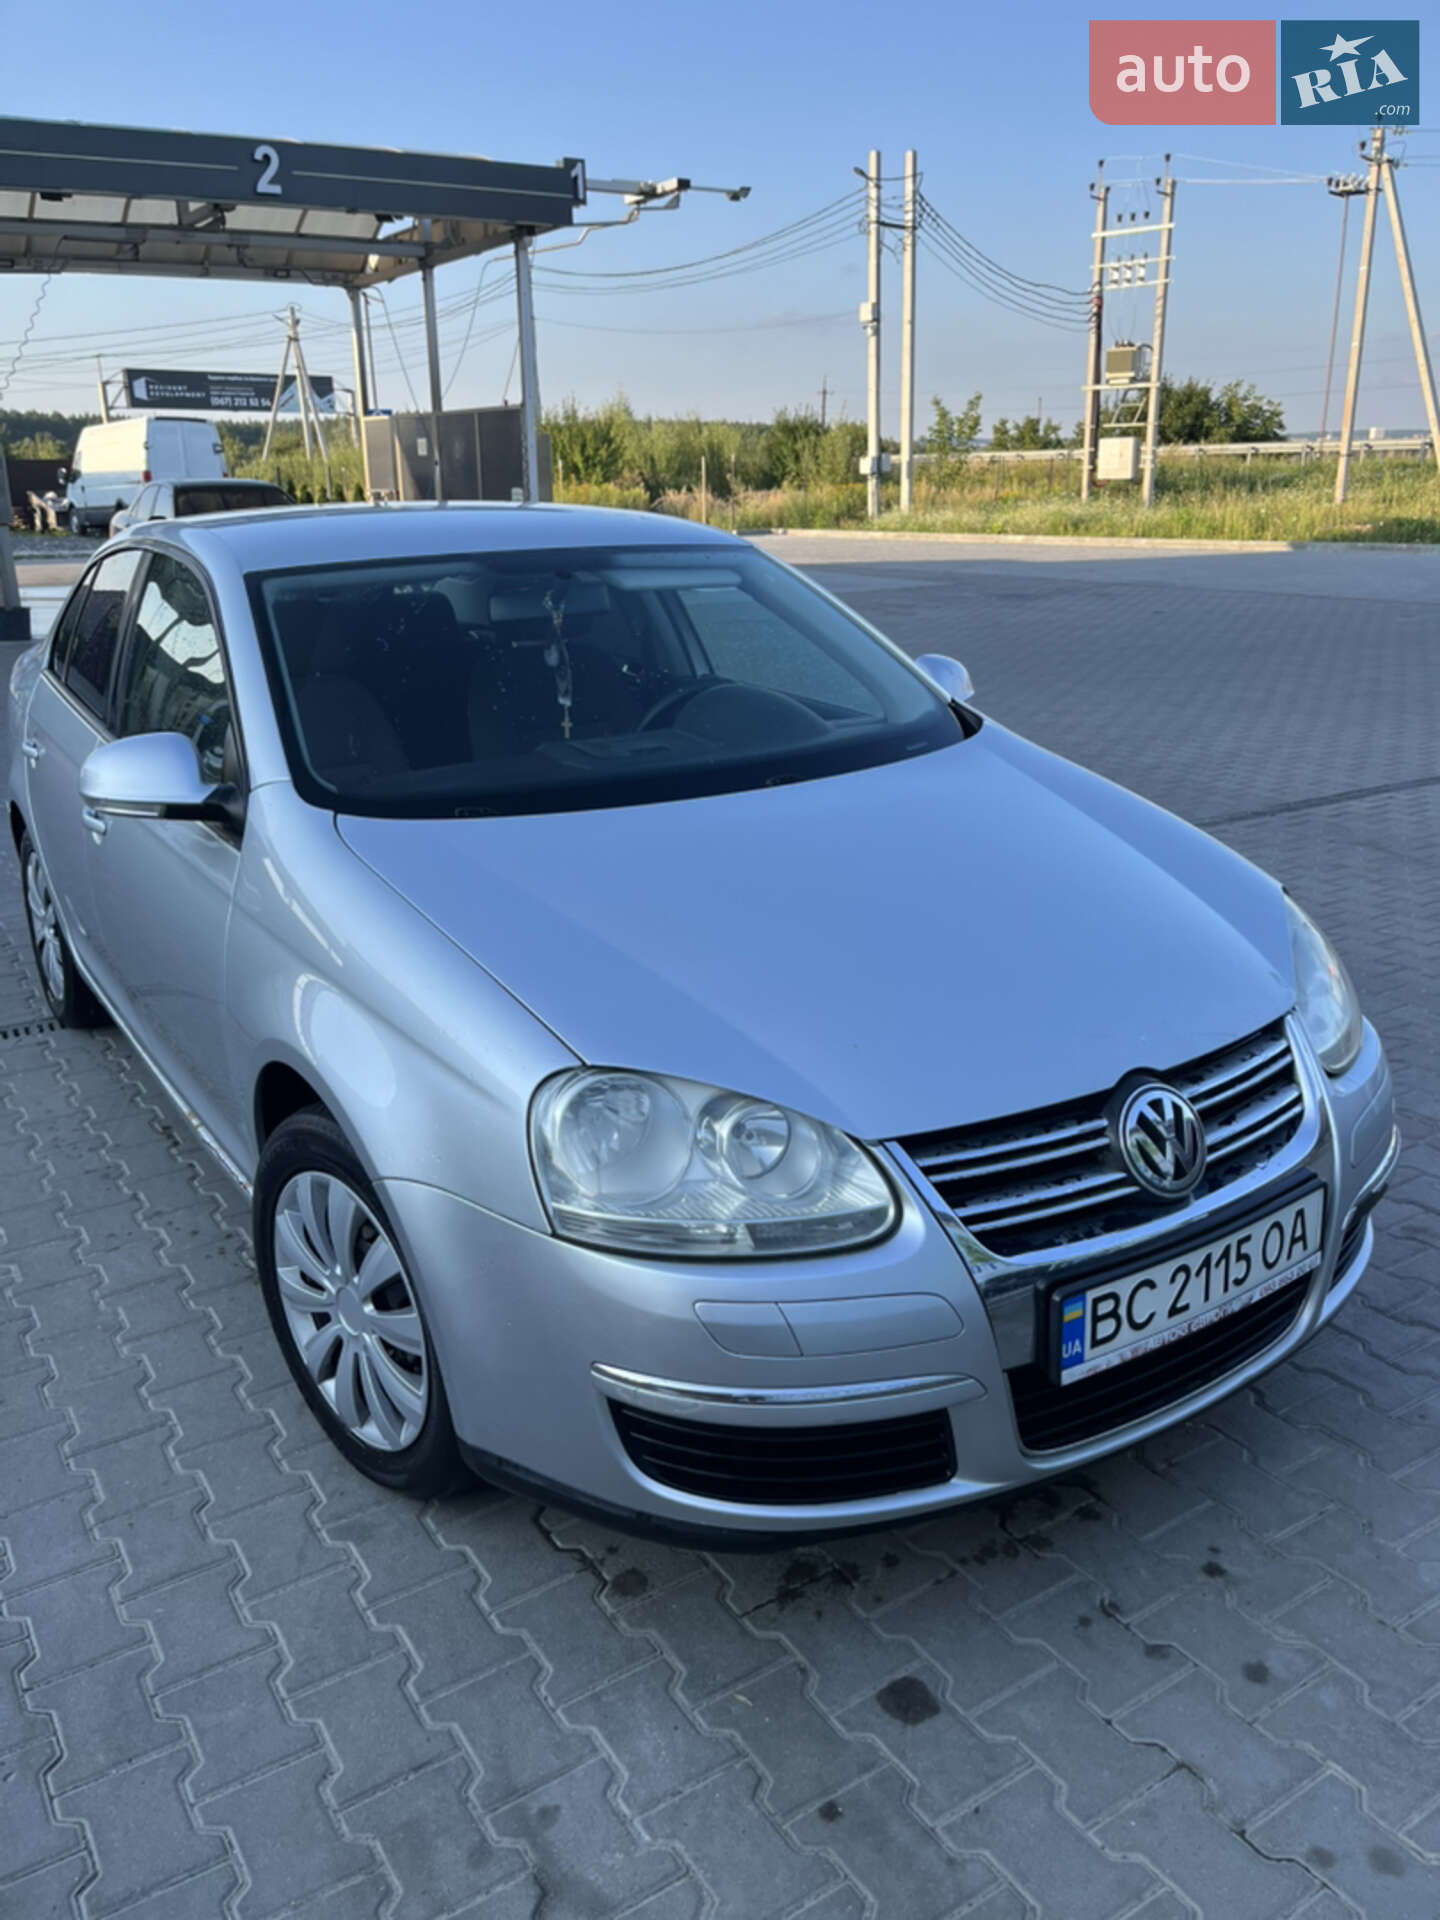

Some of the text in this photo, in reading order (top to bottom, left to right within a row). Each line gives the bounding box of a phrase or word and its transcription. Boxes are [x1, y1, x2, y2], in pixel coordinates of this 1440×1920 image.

[253, 144, 283, 195] 2
[570, 161, 586, 199] 1
[1090, 1278, 1157, 1350] BC
[1167, 1233, 1254, 1319] 2115
[1261, 1207, 1309, 1270] OA
[1062, 1338, 1082, 1359] UA
